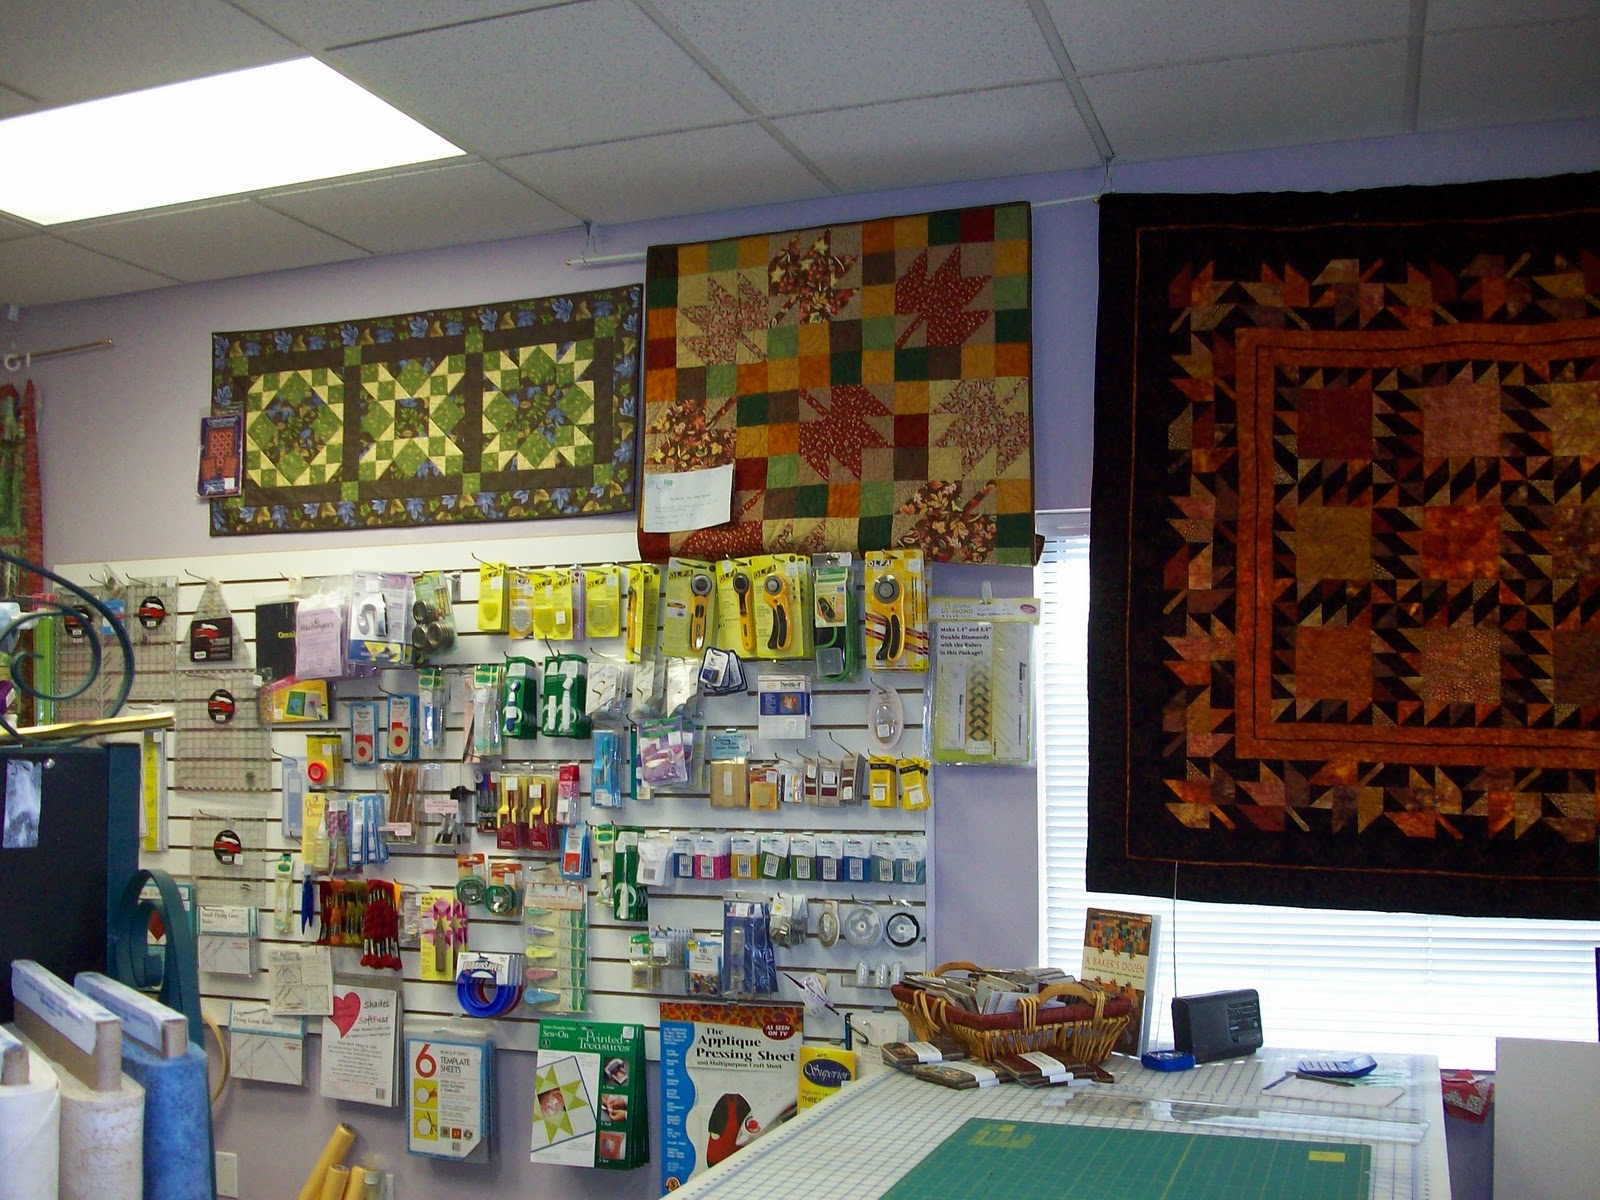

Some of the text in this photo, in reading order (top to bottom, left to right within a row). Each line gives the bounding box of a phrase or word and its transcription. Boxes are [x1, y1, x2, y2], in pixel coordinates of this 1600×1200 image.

[669, 569, 694, 580] OLFA
[754, 564, 777, 579] OLFA
[1092, 957, 1120, 970] BAKER'S
[1121, 961, 1145, 975] DOZEN
[363, 999, 390, 1009] Shades
[542, 1029, 569, 1039] Sew-On
[706, 1027, 724, 1036] The
[698, 1034, 762, 1049] Applique
[415, 1043, 437, 1078] 6
[696, 1048, 796, 1063] Pressing Sheet
[440, 1057, 470, 1067] TEMPLATE
[709, 1060, 748, 1068] Multipurpose
[440, 1065, 462, 1074] SHEETS
[804, 1062, 850, 1082] Superior
